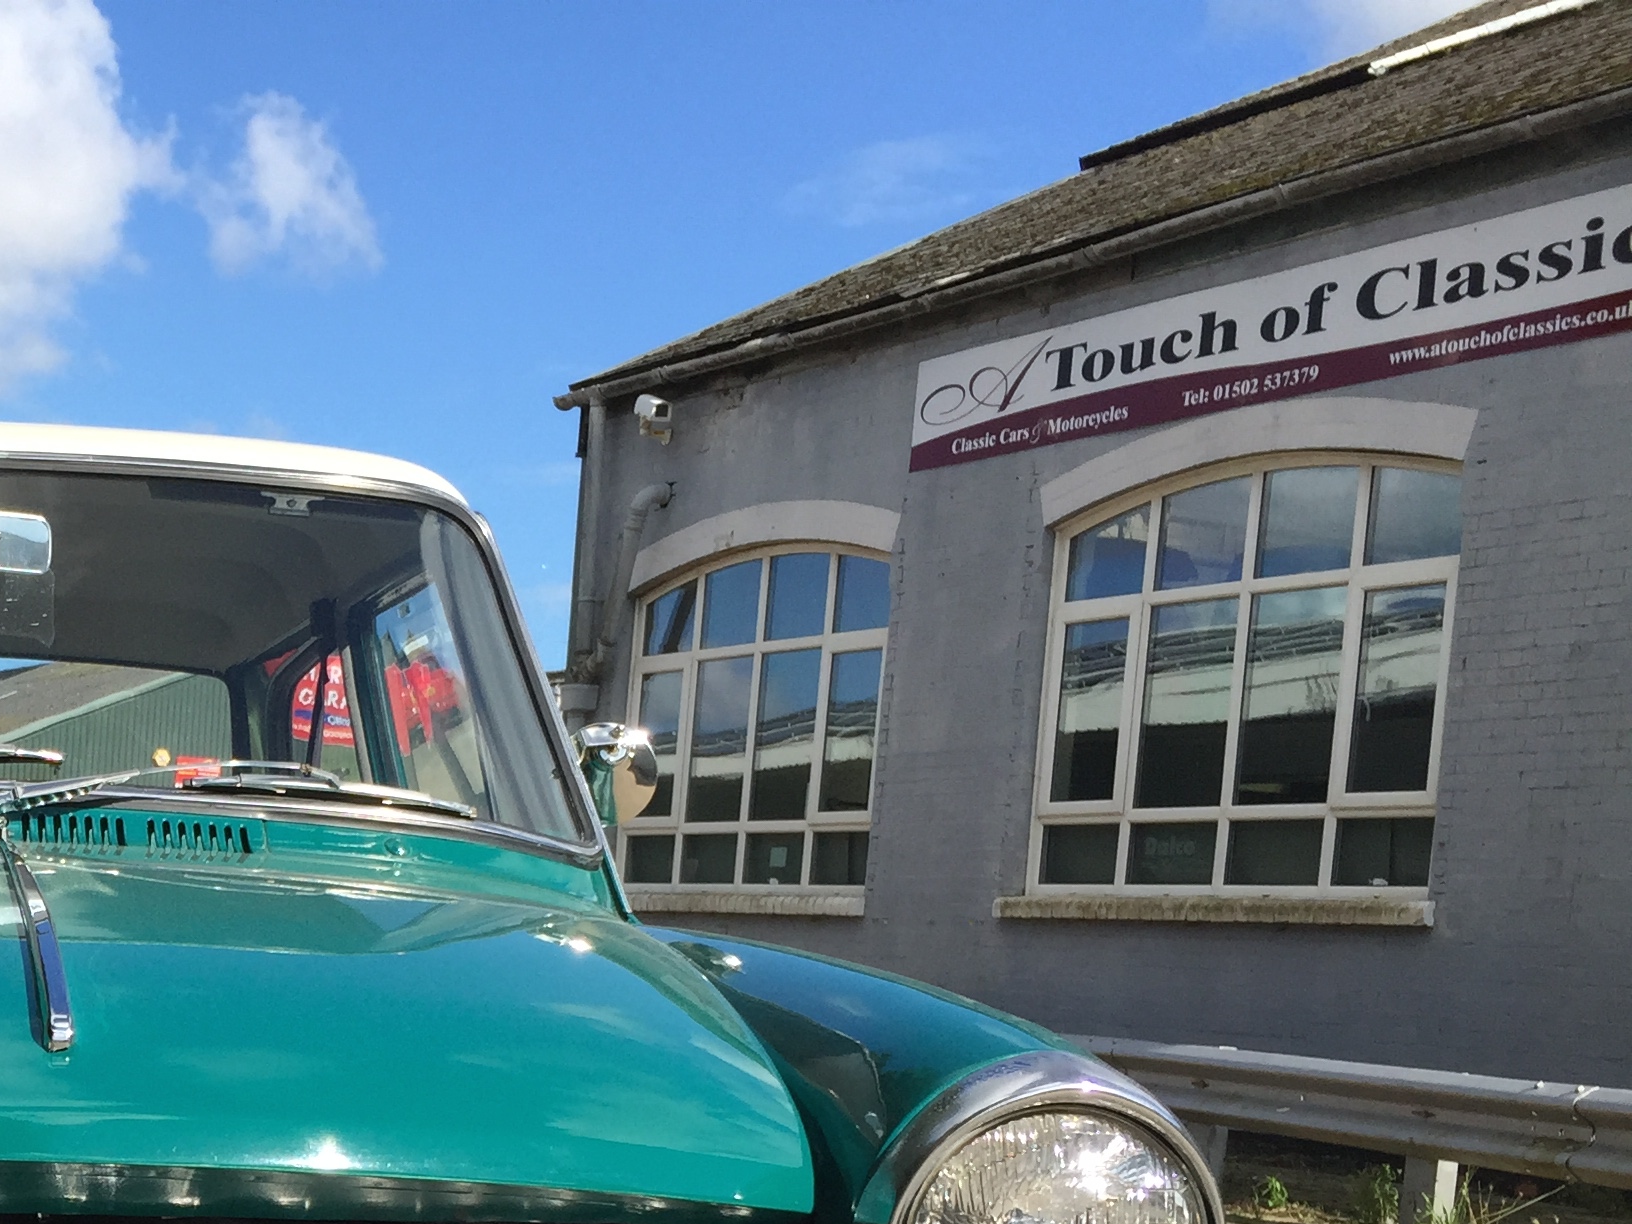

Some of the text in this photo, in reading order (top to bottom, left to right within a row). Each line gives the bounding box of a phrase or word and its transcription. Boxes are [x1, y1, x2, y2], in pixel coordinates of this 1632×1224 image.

[921, 335, 1053, 425] A
[1045, 311, 1239, 391] Touch
[1260, 281, 1338, 342] of
[1182, 364, 1319, 406] Tel: 01502 537379
[951, 431, 996, 455] Classic
[999, 426, 1030, 446] Cars
[1047, 404, 1129, 435] Motorcycles
